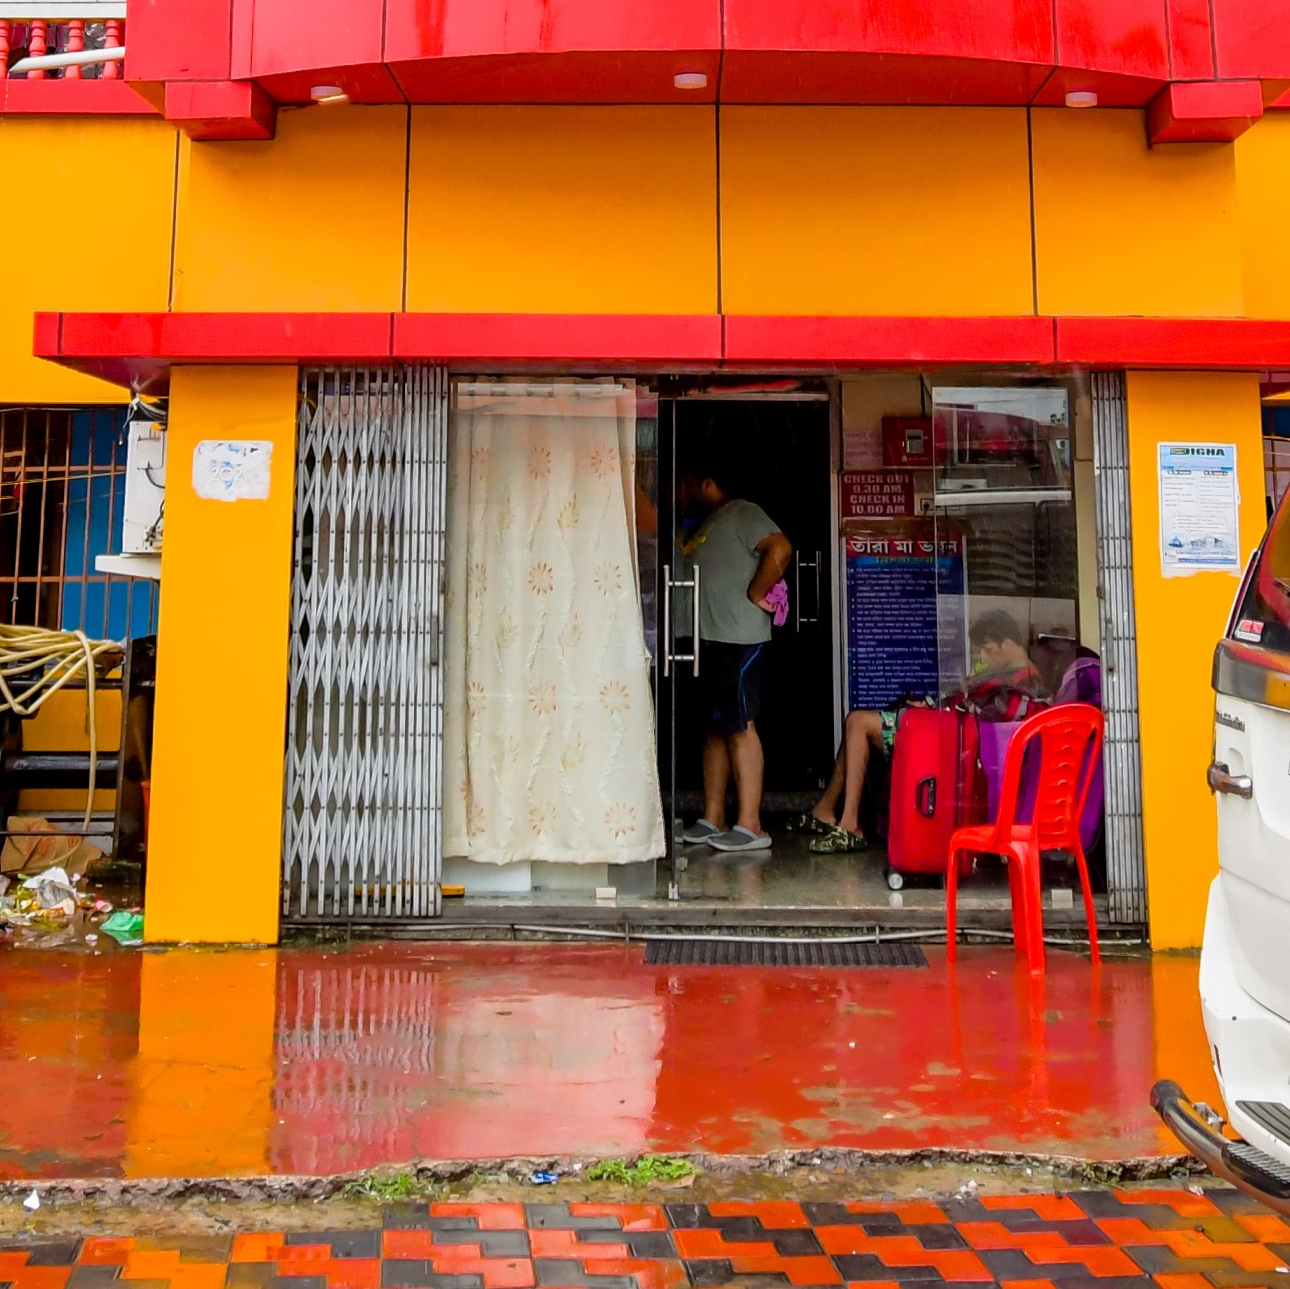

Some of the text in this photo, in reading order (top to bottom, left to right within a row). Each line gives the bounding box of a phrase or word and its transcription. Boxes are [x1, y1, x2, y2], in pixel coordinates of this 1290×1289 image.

[843, 474, 910, 484] CHECK OUT
[849, 494, 906, 504] CHECK IN
[849, 538, 890, 554] তারা
[893, 539, 914, 554] মা
